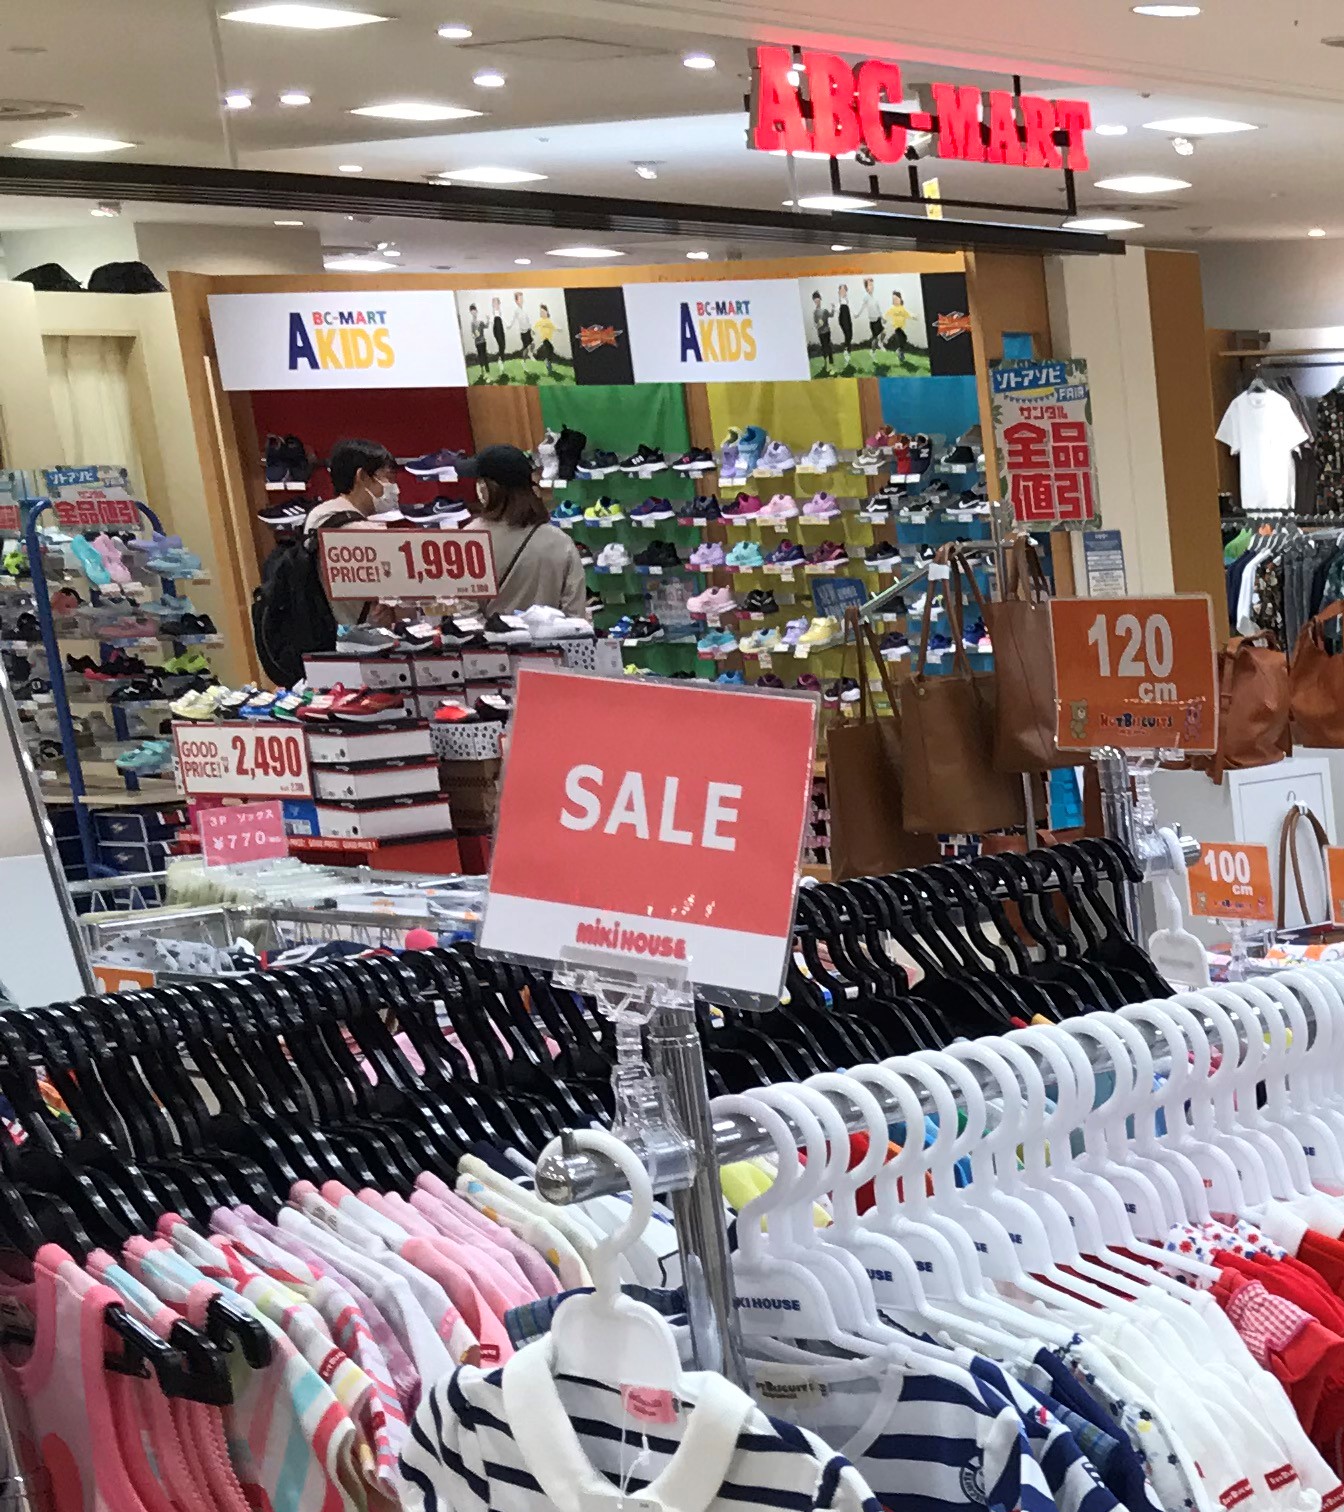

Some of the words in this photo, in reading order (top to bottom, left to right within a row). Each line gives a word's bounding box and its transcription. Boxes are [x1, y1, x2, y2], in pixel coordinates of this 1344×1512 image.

[756, 46, 1092, 170] ABC-MART
[315, 328, 395, 369] KIDS
[699, 318, 757, 362] KIDS
[996, 367, 1062, 389] ソトアソビ
[1003, 421, 1090, 470] 全品
[1010, 471, 1094, 522] 値引
[328, 547, 378, 563] GOOD
[330, 566, 381, 583] PRICE!
[398, 540, 487, 584] 1,990
[1088, 613, 1174, 678] 120
[1138, 682, 1178, 702] cm
[181, 741, 218, 758] GOOD
[231, 735, 302, 780] 2,490
[560, 764, 743, 852] SALE
[1204, 850, 1251, 883] 100
[1231, 883, 1254, 896] cm
[751, 1298, 801, 1312] HOUSE
